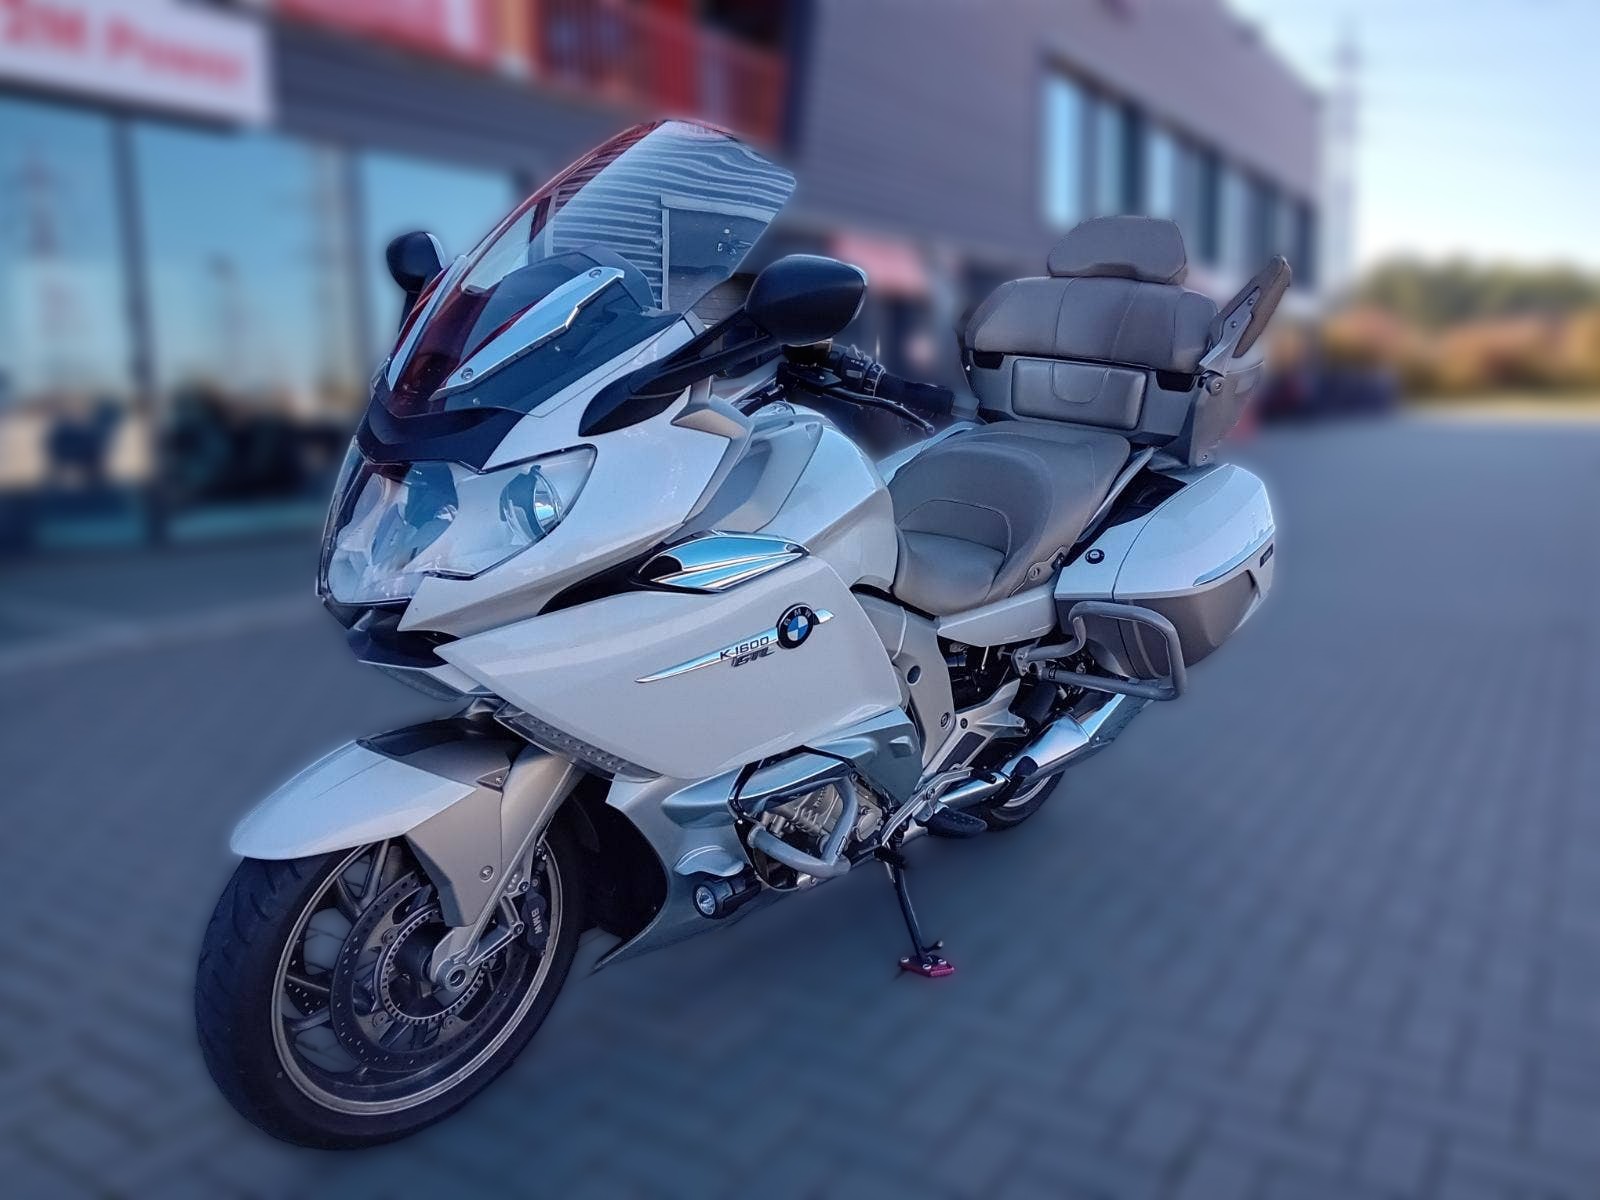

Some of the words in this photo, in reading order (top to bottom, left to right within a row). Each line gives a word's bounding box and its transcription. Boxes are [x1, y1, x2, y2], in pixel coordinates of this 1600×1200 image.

[783, 608, 812, 626] BMW
[720, 649, 731, 660] K
[735, 636, 769, 655] 1600
[531, 907, 543, 934] BMW
